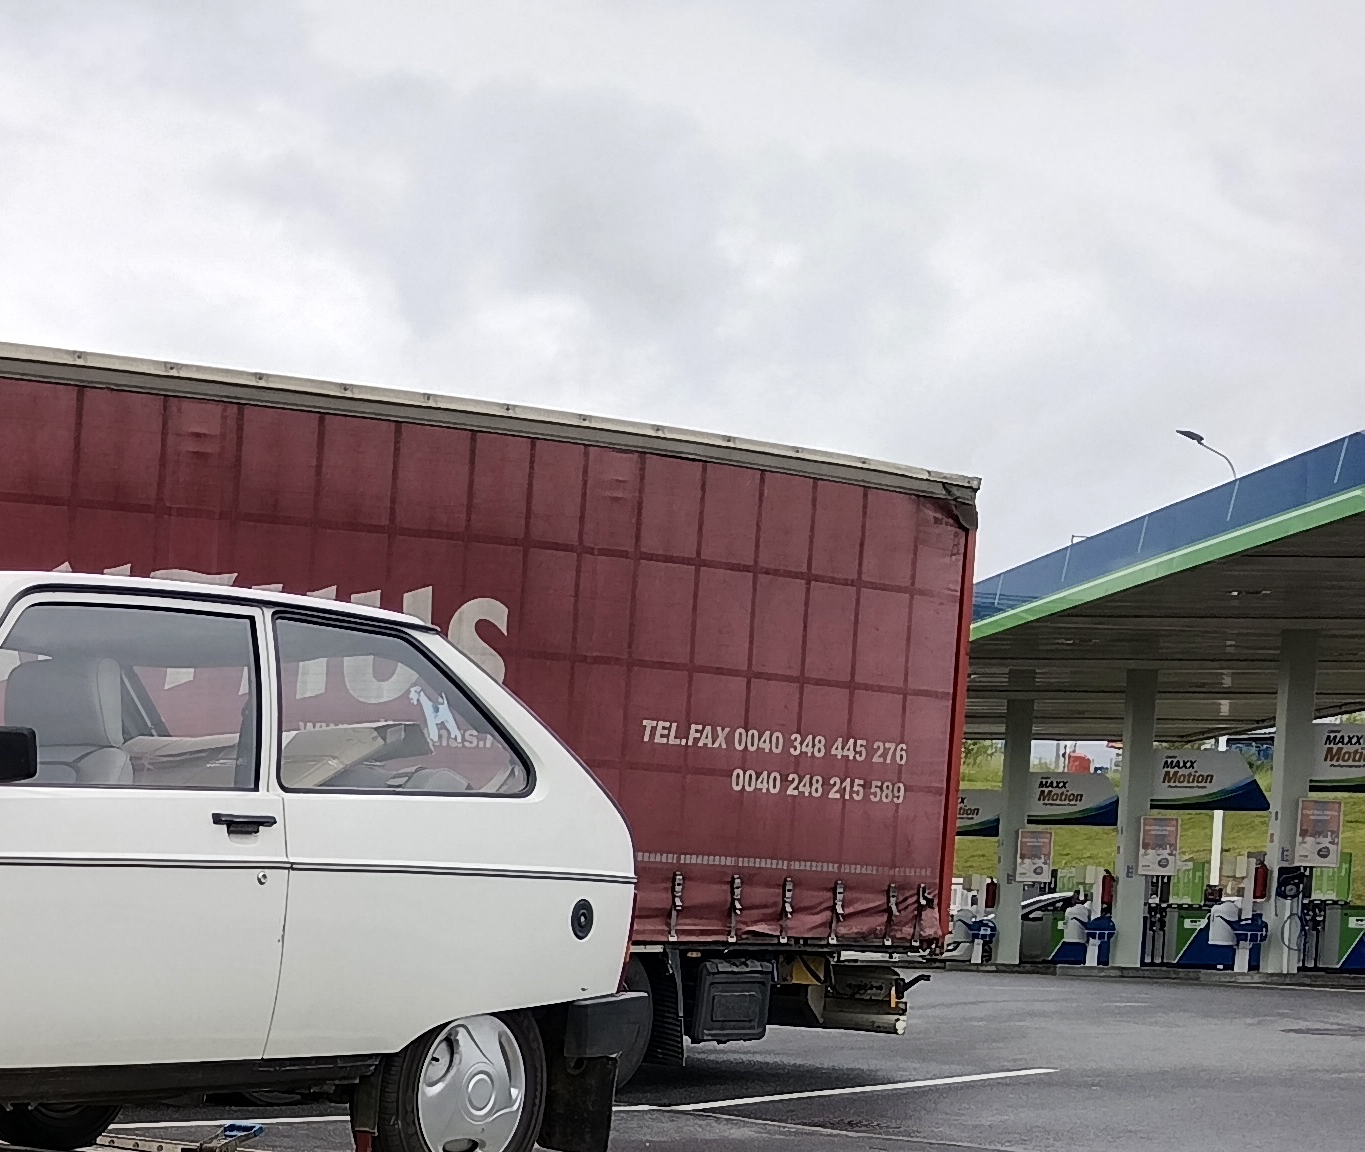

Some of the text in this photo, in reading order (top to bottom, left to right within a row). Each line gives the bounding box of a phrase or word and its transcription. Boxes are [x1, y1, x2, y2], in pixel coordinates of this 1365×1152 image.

[642, 719, 907, 764] TEL.FAX 0040 348 445 276
[1324, 734, 1364, 746] MAXX
[1324, 746, 1365, 762] Moti
[1163, 759, 1197, 769] MAXX
[1162, 770, 1214, 784] Motion
[731, 768, 905, 803] 0040 248 215 589
[1038, 780, 1069, 789] MAXX
[1038, 790, 1083, 803] Motion
